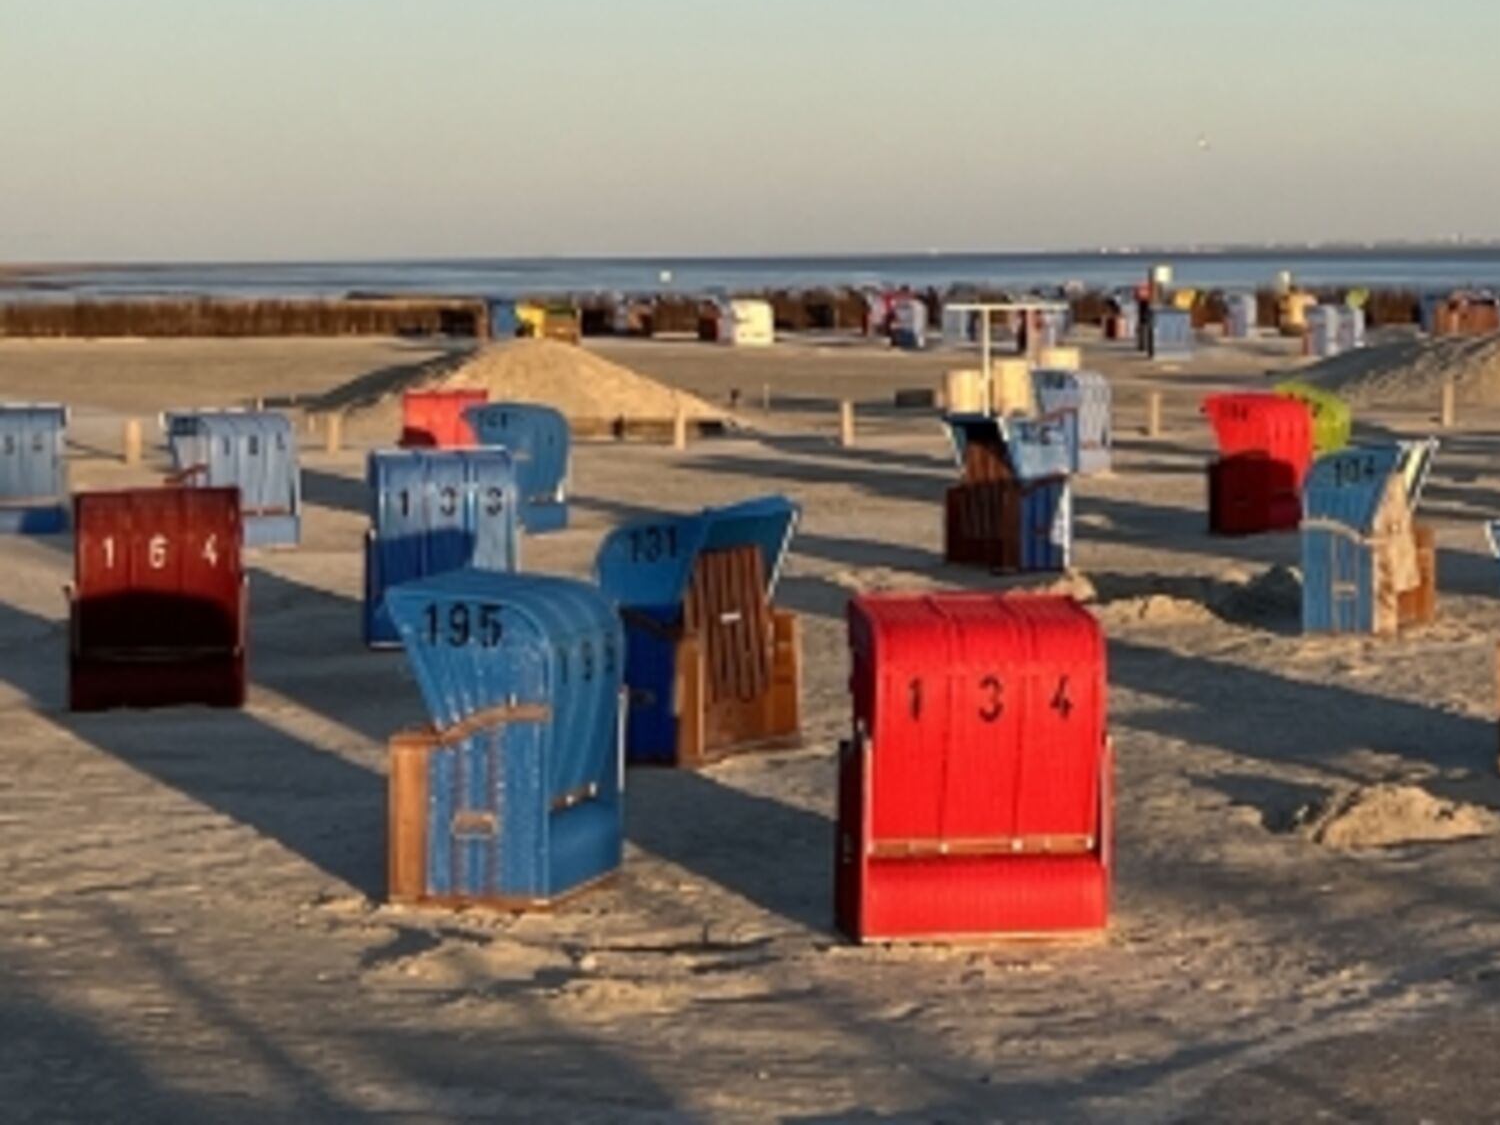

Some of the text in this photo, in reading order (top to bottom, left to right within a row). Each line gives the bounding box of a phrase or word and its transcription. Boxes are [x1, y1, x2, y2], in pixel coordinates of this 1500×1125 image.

[101, 533, 219, 569] 164
[629, 525, 678, 563] 131
[423, 602, 503, 649] 195
[907, 675, 1074, 723] 134
